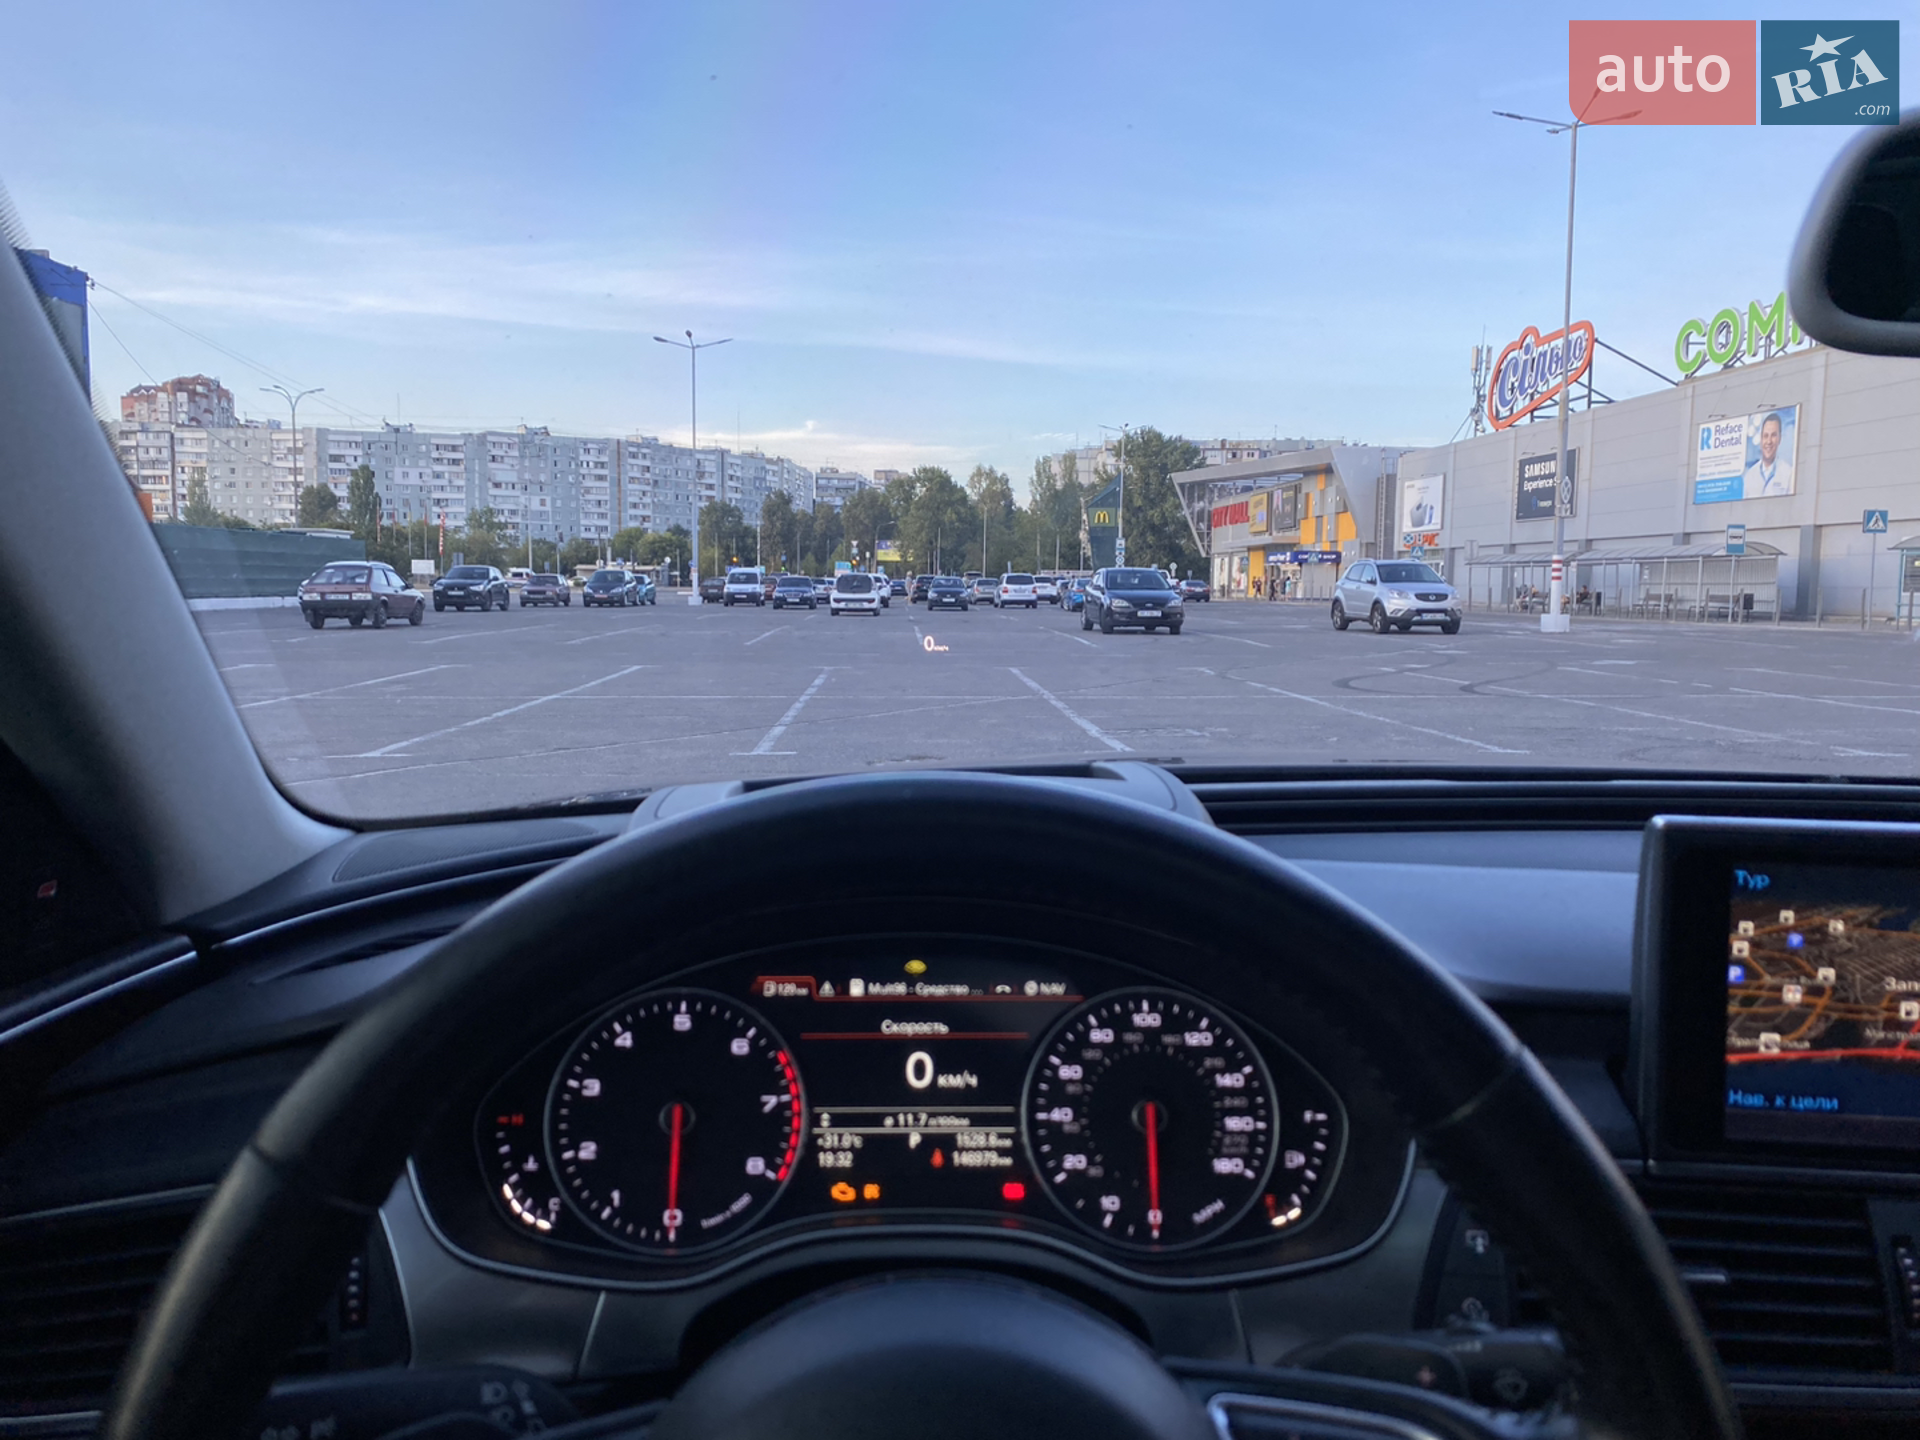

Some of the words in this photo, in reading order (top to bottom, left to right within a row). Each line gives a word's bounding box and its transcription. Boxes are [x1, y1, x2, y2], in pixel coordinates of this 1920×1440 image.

[1675, 290, 1800, 374] COM
[1714, 423, 1744, 437] Reface
[1713, 434, 1742, 449] Dental
[1524, 460, 1557, 478] SAMSUN
[1523, 477, 1553, 493] Experience
[924, 635, 935, 652] 0
[1734, 869, 1770, 889] Тур
[1040, 982, 1067, 995] NAV
[881, 1019, 949, 1037] Скорость
[1132, 1012, 1162, 1028] 100
[614, 1031, 633, 1049] 4
[1089, 1027, 1115, 1043] 80
[1183, 1031, 1214, 1047] 120
[905, 1050, 935, 1089] 0
[937, 1070, 978, 1089] км/ч
[1058, 1064, 1083, 1080] 60
[581, 1078, 601, 1097] 3
[1215, 1072, 1245, 1088] 140
[760, 1094, 778, 1113] 7
[1776, 1095, 1786, 1107] к
[1049, 1106, 1073, 1123] 40
[1224, 1116, 1255, 1132] 160
[909, 1132, 922, 1149] P
[578, 1141, 598, 1160] 2
[1062, 1153, 1088, 1170] 20
[610, 1189, 621, 1207] 1
[1100, 1195, 1120, 1211] 10
[662, 1208, 683, 1228] 0
[1148, 1209, 1162, 1224] 0
